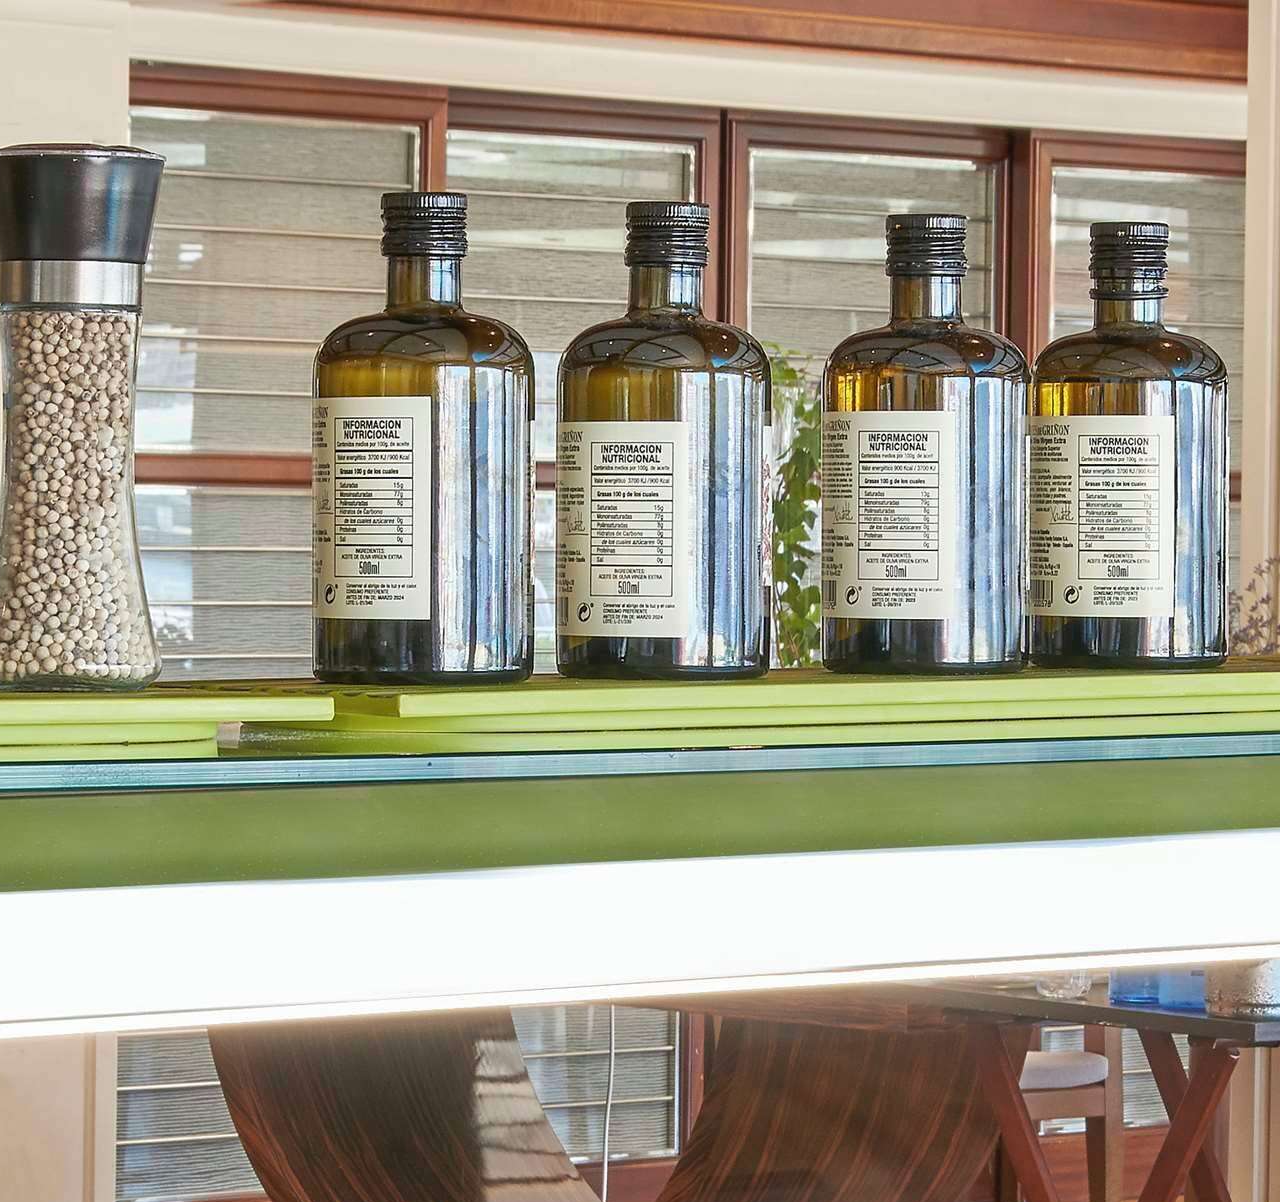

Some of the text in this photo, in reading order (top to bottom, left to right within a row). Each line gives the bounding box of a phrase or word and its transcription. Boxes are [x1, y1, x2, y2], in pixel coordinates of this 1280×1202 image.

[343, 420, 401, 429] INFORMACION
[344, 430, 400, 439] NUTRICIONAL
[868, 433, 928, 442] INFORMACION
[1089, 437, 1149, 446] INFORMACION
[601, 445, 662, 453] INFORMACION
[869, 443, 926, 451] NUTRICIONAL
[1090, 447, 1148, 455] NUTRICIONAL
[602, 454, 661, 463] NUTRICIONAL
[359, 561, 380, 574] 500ml
[885, 565, 907, 578] 500ml
[1107, 565, 1129, 577] 500ml
[618, 581, 639, 594] 500ml
